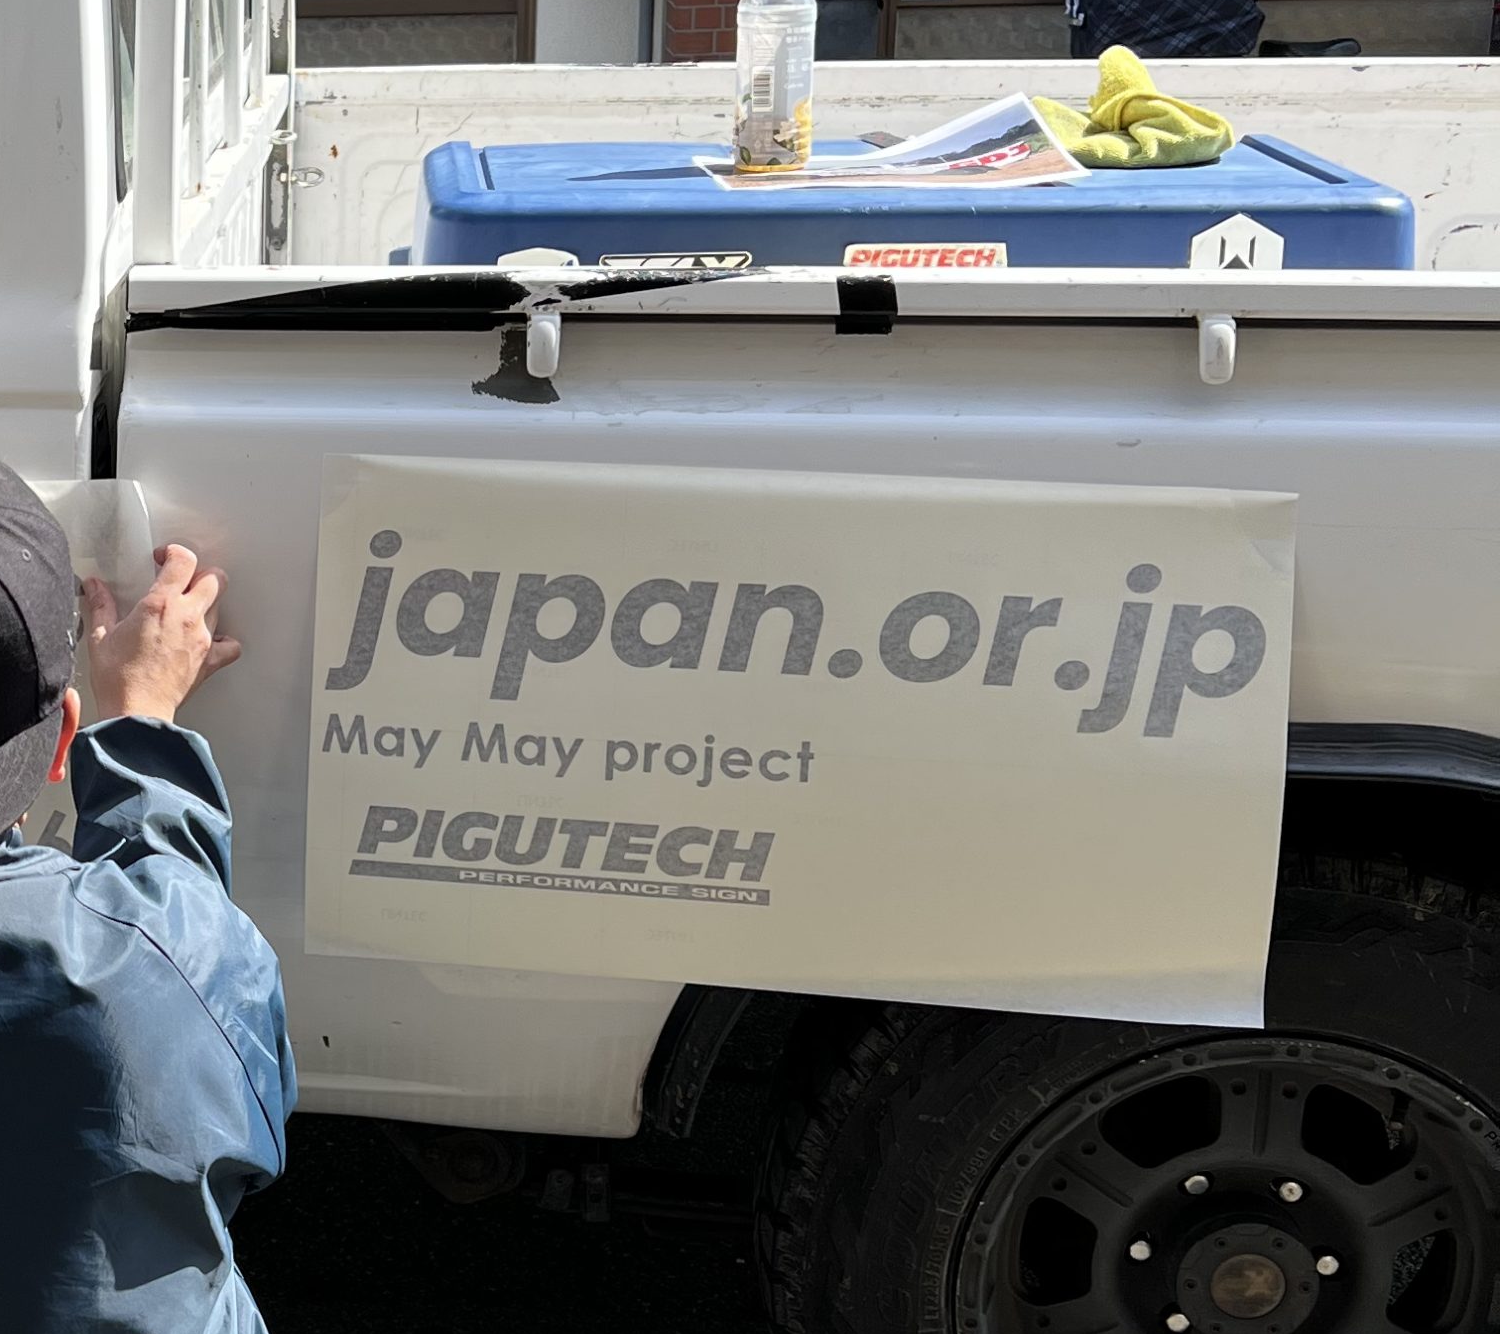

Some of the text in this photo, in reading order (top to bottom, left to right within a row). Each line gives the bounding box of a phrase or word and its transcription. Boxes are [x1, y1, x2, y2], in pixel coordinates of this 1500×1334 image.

[850, 248, 997, 267] PIGUTECH
[326, 528, 1267, 737] japan.or.jp
[321, 713, 816, 787] May May project
[356, 805, 775, 883] PIGUTECH
[458, 869, 759, 902] PERFORMANCE SIGN
